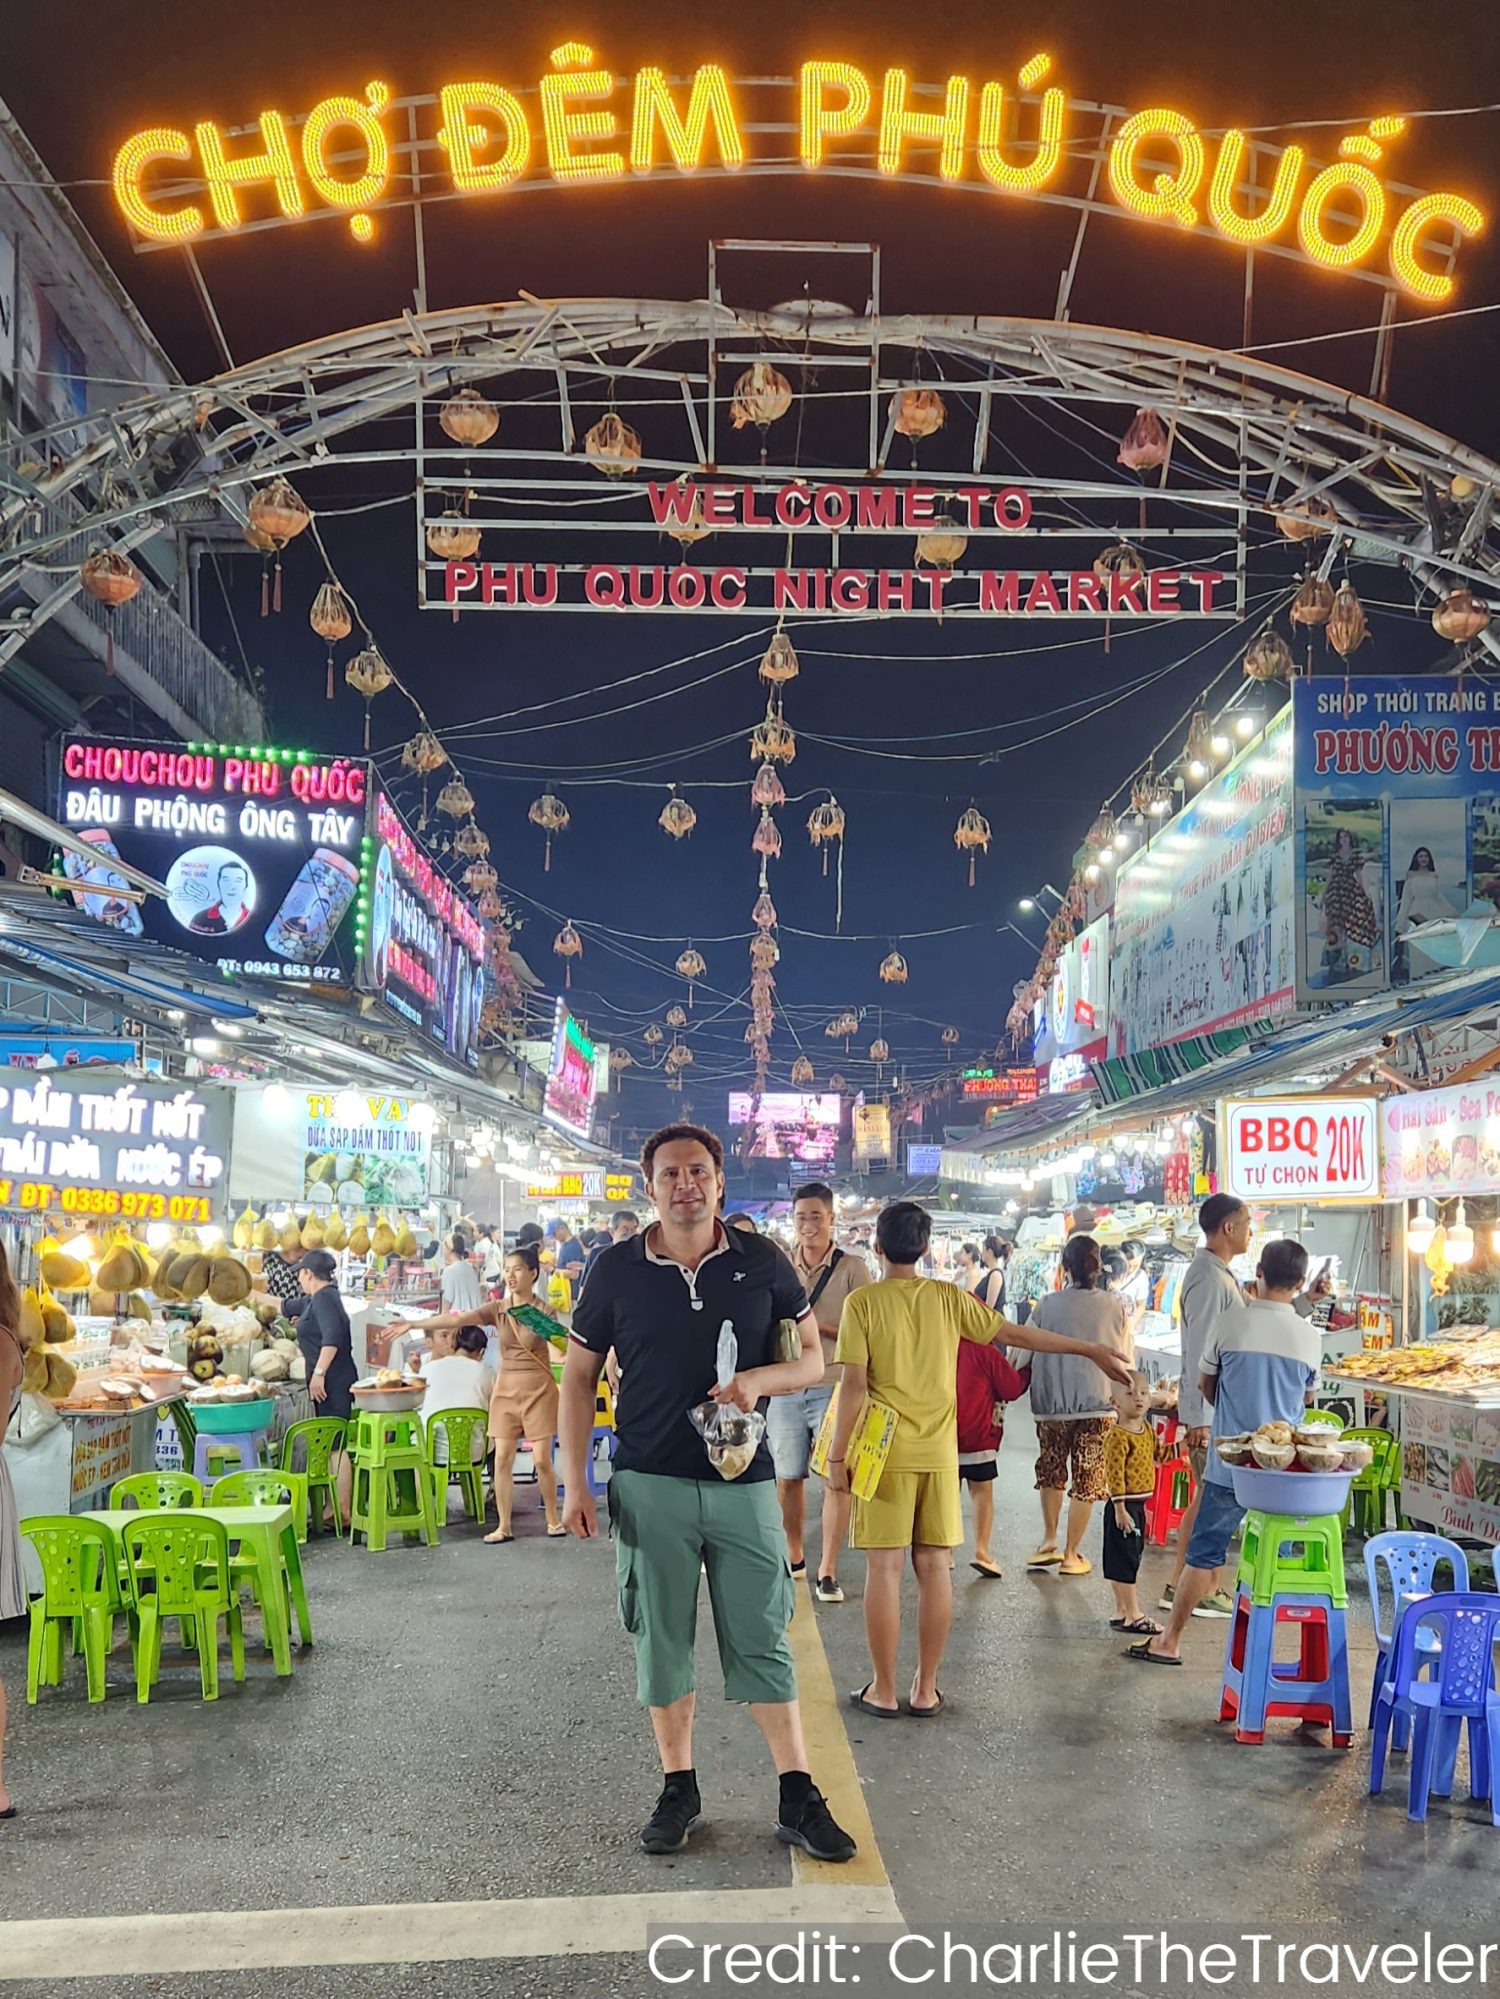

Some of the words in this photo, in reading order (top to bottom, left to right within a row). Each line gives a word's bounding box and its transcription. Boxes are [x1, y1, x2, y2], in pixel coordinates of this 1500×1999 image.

[113, 80, 390, 241] CHỢ
[437, 42, 743, 193] ĐÊM
[799, 52, 1065, 192] PHÚ
[1109, 115, 1485, 300] QUỐC
[648, 481, 937, 531] WELCOME
[959, 486, 1034, 532] TO
[444, 560, 559, 606] PHU
[583, 564, 747, 610] QUOC
[773, 566, 953, 613] NIGHT
[979, 570, 1224, 616] MARKET
[1316, 692, 1368, 714] SHOP
[1374, 688, 1418, 714] THỜI
[1425, 691, 1487, 713] TRANG
[65, 744, 214, 790] CHOUCHOU
[1313, 720, 1460, 774] PHƯƠNG
[134, 794, 226, 838] PHỘNG
[239, 800, 296, 841] ÔNG
[308, 807, 354, 845] TÂY
[244, 960, 280, 975] 0943
[283, 963, 310, 977] 653
[312, 966, 341, 980] 872
[1240, 1115, 1318, 1158] BBQ
[1326, 1115, 1366, 1182] 20K
[1244, 1164, 1267, 1188] TỰ
[1273, 1165, 1319, 1187] CHỌN
[61, 1186, 121, 1215] 0336
[121, 1192, 167, 1219] 973
[168, 1195, 212, 1222] 071
